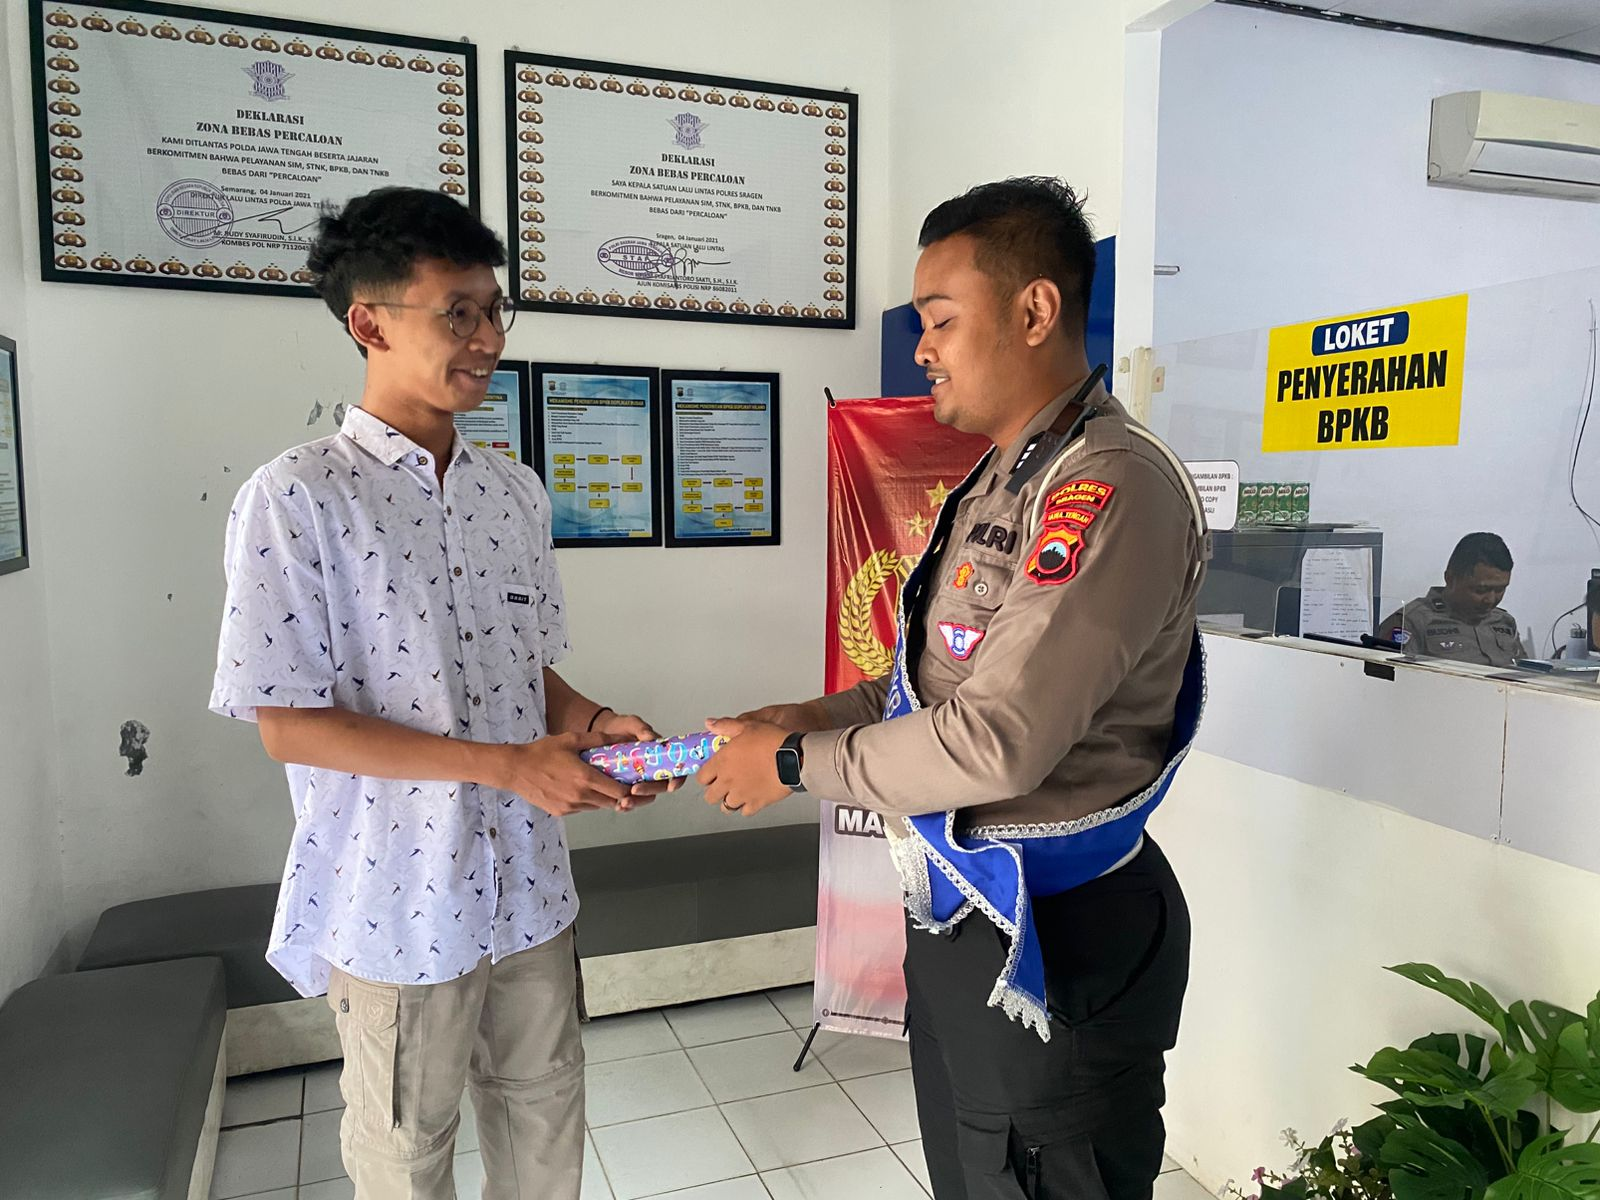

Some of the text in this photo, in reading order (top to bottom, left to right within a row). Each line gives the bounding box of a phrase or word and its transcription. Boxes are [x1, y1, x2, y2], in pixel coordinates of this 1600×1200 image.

[236, 109, 304, 125] DEKLARASI
[196, 122, 343, 145] ZONA BEBAS PERCALOAN
[161, 136, 379, 164] KAMI DITLANTAS POLDA JAWA TENGAH BESERTA JAJARAN
[661, 153, 715, 167] DEKLARASI
[147, 147, 390, 177] BERKOMITMEN BAHWA PELAYANAN SIM, STNK, BPKB, DAN TNKB
[221, 168, 247, 176] BEBAS
[248, 170, 267, 178] DARI
[629, 165, 745, 185] ZONA BEBAS PERCALOAN
[220, 186, 257, 195] Semarang,
[269, 189, 294, 198] Januari
[611, 179, 627, 187] SAYA
[628, 181, 652, 189] KEPALA
[652, 183, 677, 192] SATUAN
[715, 189, 738, 197] POLRES
[739, 191, 763, 200] SRAGEN
[269, 198, 291, 206] POLDA
[293, 200, 312, 208] JAWA
[590, 189, 639, 200] BERKOMITMEN
[639, 193, 663, 202] BAHWA
[664, 196, 700, 206] PELAYANAN
[700, 199, 714, 208] SIM,
[715, 201, 732, 209] STNK,
[733, 203, 751, 211] BPKB,
[766, 205, 782, 213] TNKB
[649, 206, 669, 214] BEBAS
[669, 208, 685, 216] DARI
[176, 209, 215, 217] DIREKTUR
[1323, 317, 1395, 352] LOKET
[1277, 349, 1448, 403] PENYERAHAN
[1317, 405, 1389, 444] BPKB
[1051, 483, 1107, 501] POLRES
